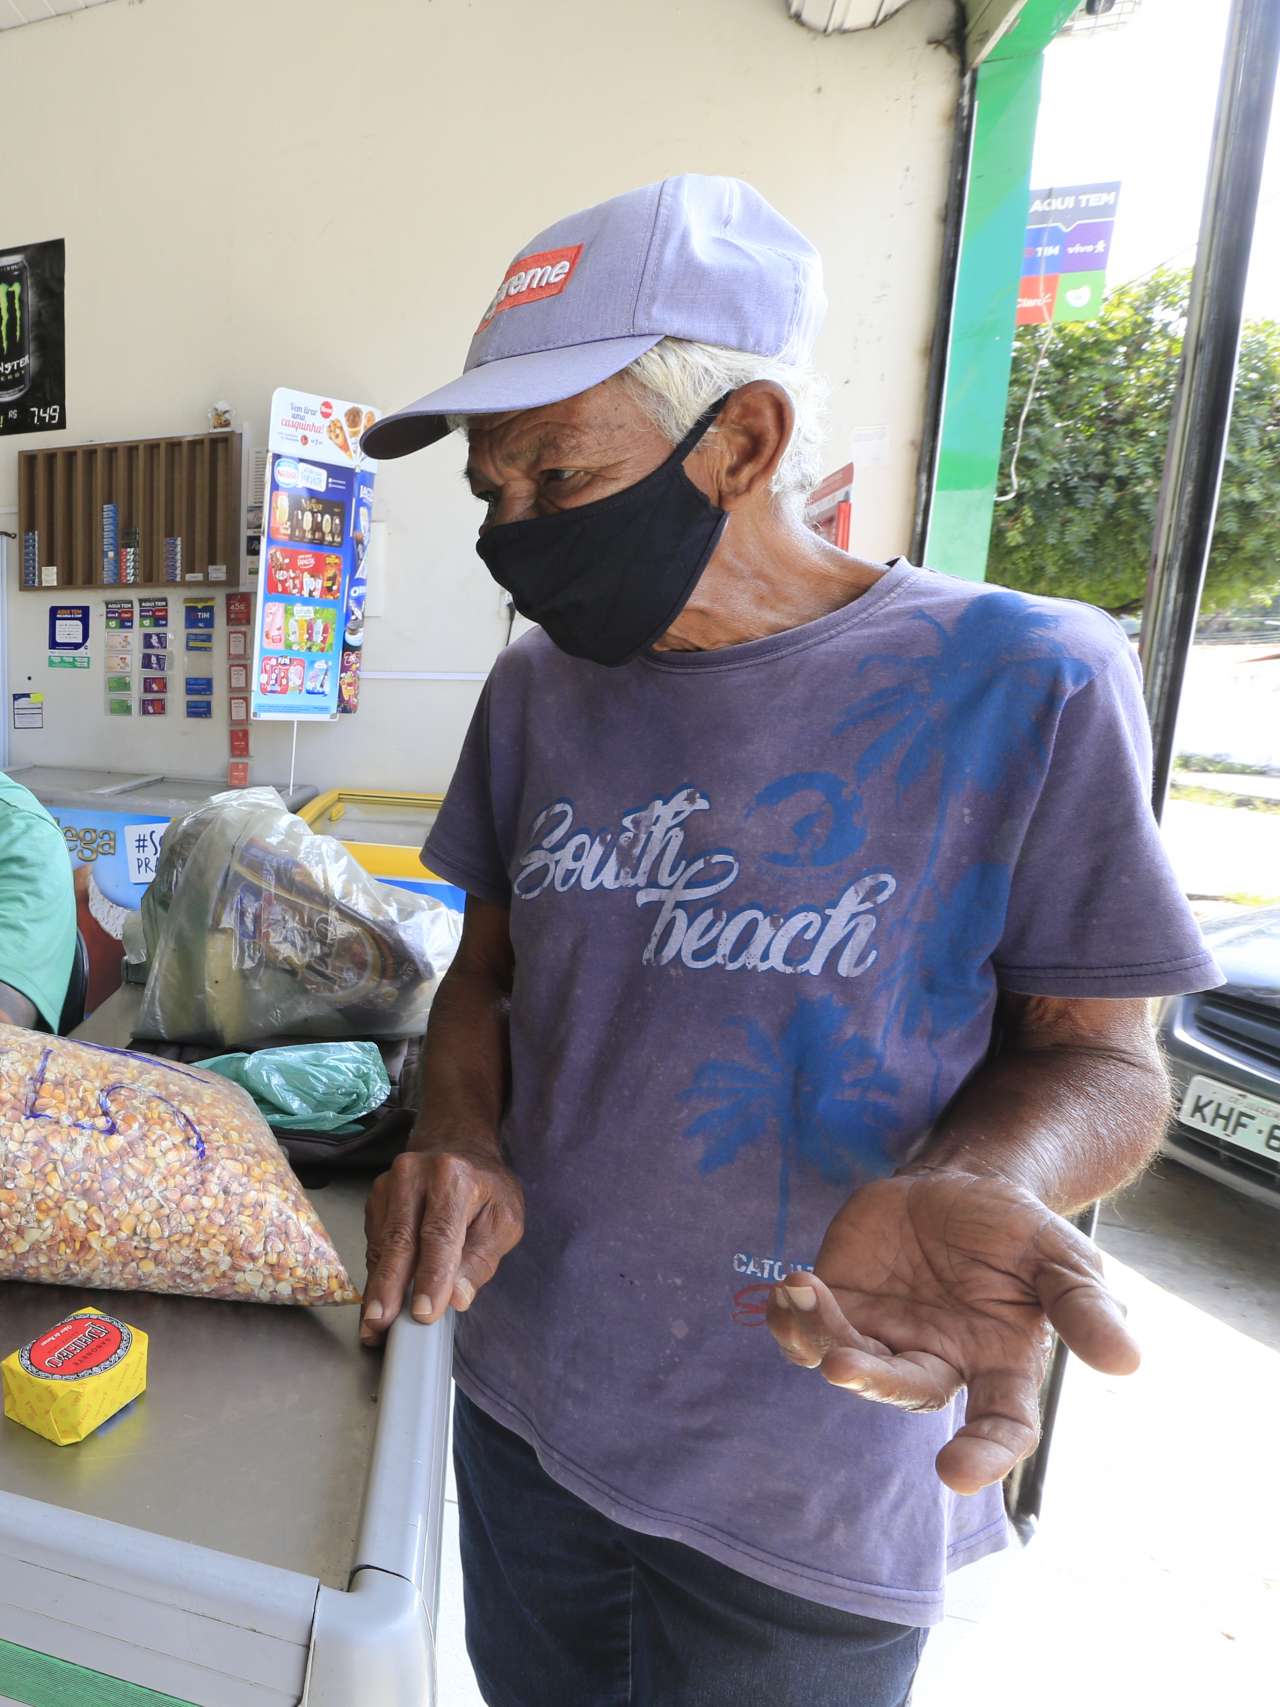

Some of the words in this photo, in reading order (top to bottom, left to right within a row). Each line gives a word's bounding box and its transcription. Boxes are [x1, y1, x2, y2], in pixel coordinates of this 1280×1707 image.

[1029, 195, 1076, 213] AQUI
[1078, 191, 1117, 208] TEM
[1036, 246, 1059, 257] TIM
[1067, 244, 1094, 254] vivo
[197, 611, 210, 619] TIM
[54, 817, 116, 862] ega
[135, 830, 163, 856] #S
[514, 788, 710, 900] South
